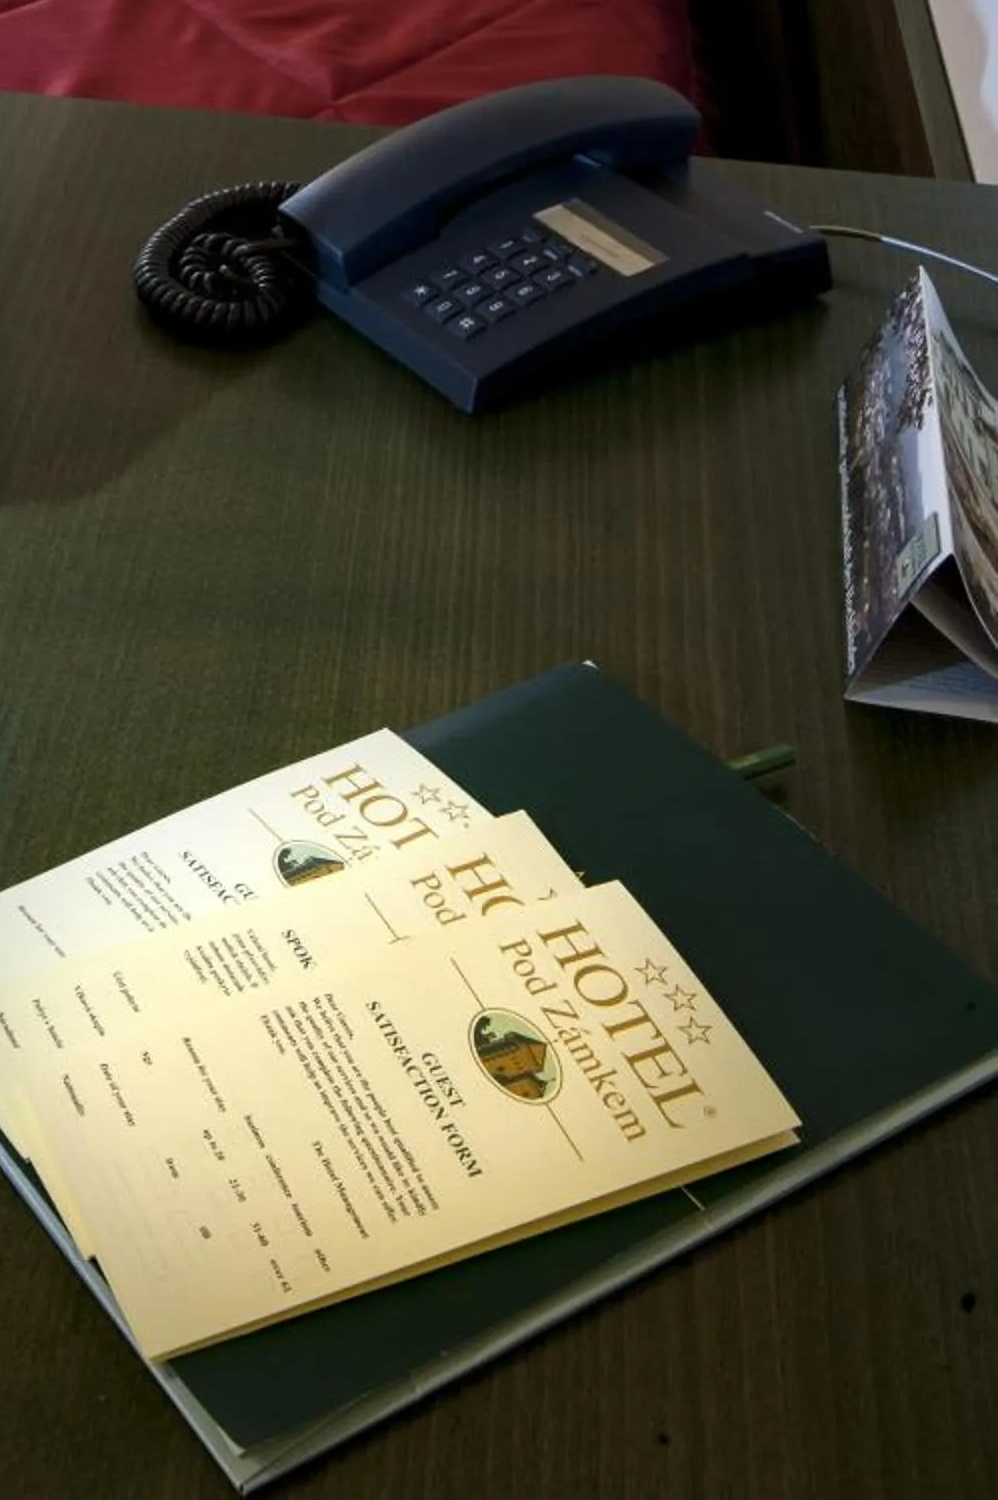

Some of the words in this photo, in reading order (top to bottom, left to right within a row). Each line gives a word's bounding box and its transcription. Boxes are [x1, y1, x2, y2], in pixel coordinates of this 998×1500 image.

[290, 784, 346, 828] Pod
[321, 764, 439, 849] HOT
[410, 871, 467, 926] Pod
[500, 939, 557, 996] Pod
[541, 1000, 646, 1142] Zámkem
[536, 919, 704, 1128] HOTEL
[366, 1001, 448, 1121] SATISFACTION
[441, 1123, 483, 1178] FORM
[421, 1052, 466, 1107] GUEST
